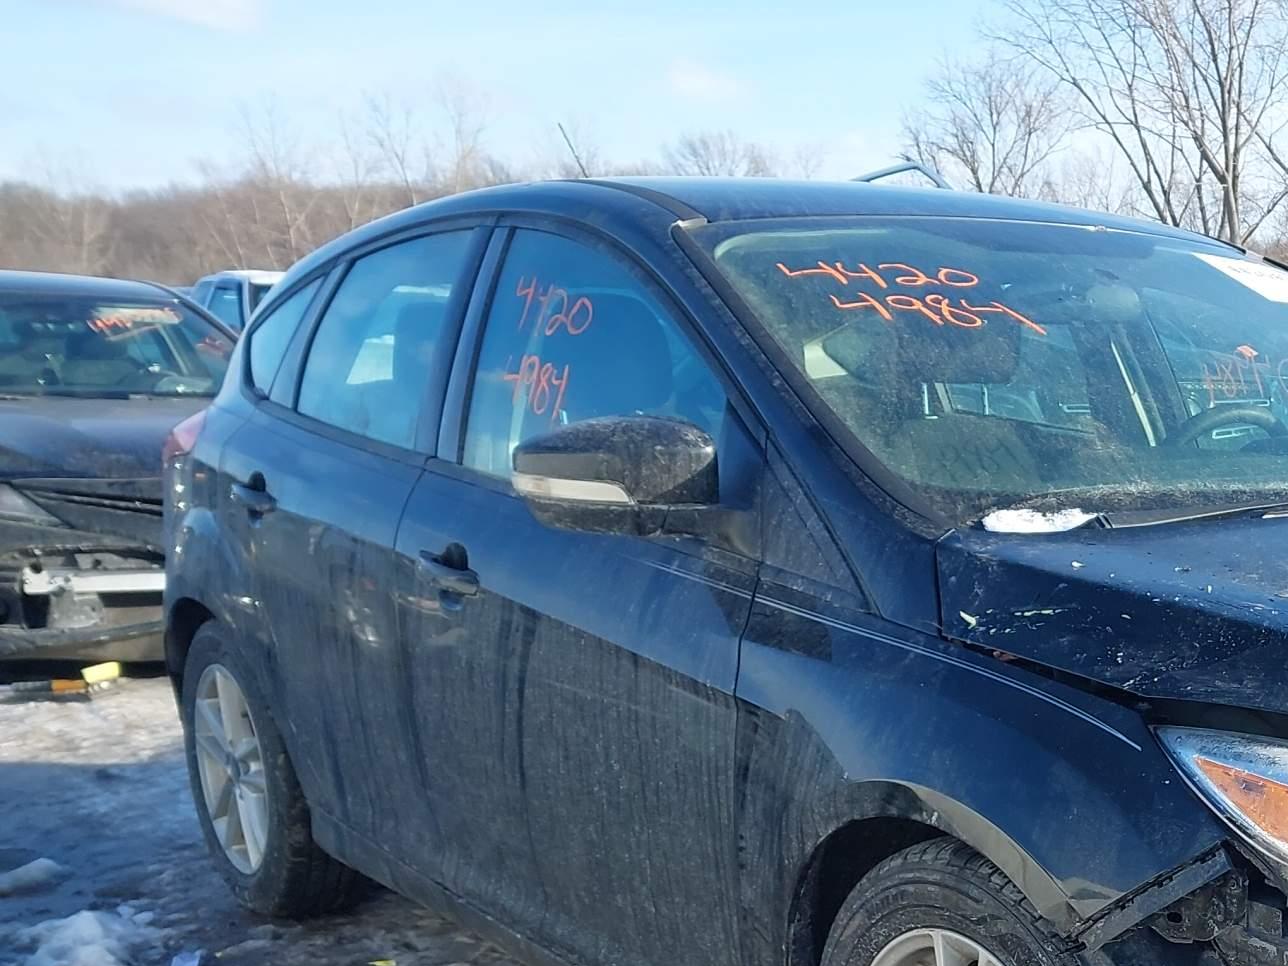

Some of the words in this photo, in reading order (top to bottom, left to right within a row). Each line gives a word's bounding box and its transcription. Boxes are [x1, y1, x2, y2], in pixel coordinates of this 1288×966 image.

[776, 261, 979, 288] 4420
[516, 275, 593, 336] 4420
[829, 292, 1048, 335] 4984
[503, 354, 569, 421] 4984
